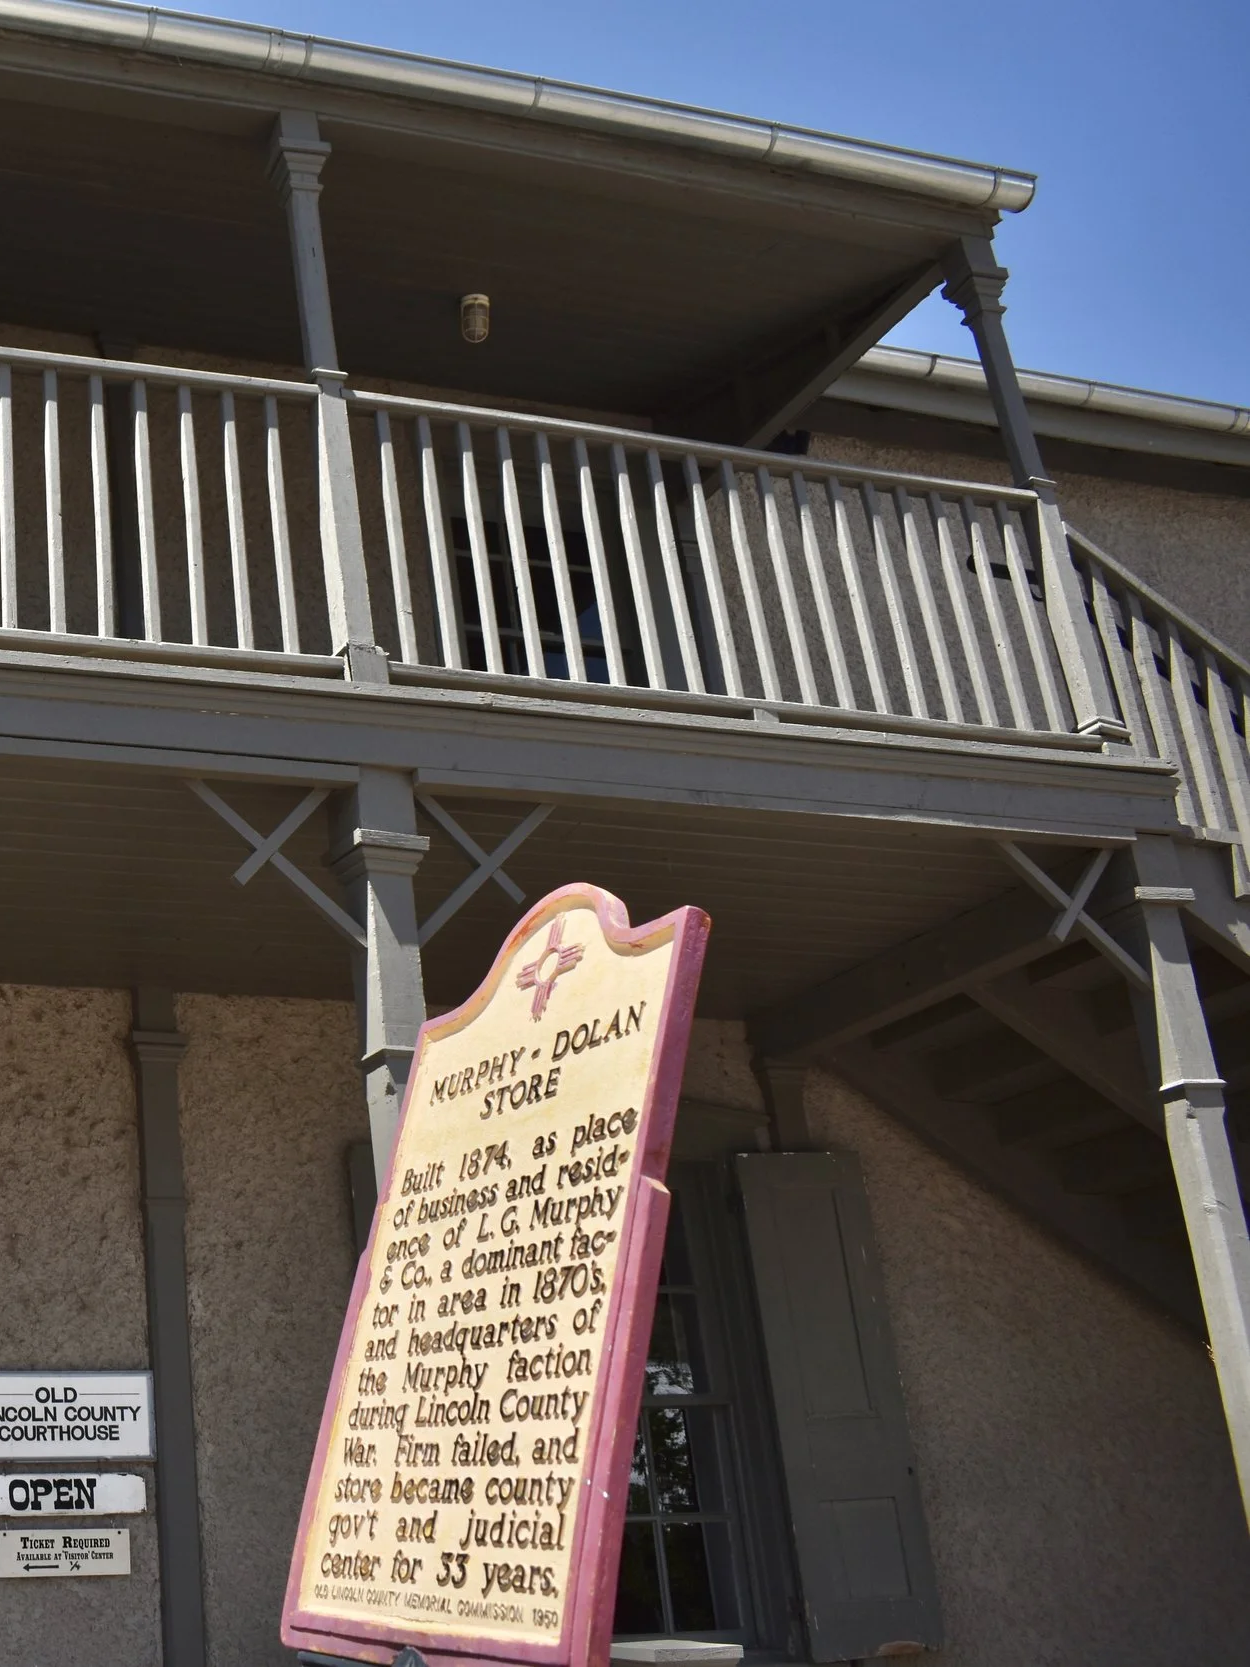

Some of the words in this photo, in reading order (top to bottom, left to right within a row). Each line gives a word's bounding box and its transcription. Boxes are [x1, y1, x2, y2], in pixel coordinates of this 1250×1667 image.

[429, 1046, 526, 1107] MURPHY
[551, 1000, 647, 1062] DOLAN
[480, 1066, 561, 1120] STORE
[401, 1160, 445, 1197] Built
[459, 1140, 512, 1181] 1874,
[532, 1130, 558, 1159] as
[570, 1107, 639, 1157] place
[393, 1197, 415, 1231] of
[417, 1181, 499, 1225] business
[505, 1164, 547, 1202] and
[557, 1144, 631, 1193] resid-
[387, 1232, 431, 1264] ence
[443, 1217, 467, 1250] of
[476, 1210, 495, 1243] L.
[529, 1184, 624, 1232] Murphy
[380, 1264, 393, 1295] &
[440, 1259, 453, 1283] a
[461, 1232, 565, 1278] dominant
[570, 1226, 617, 1261] fac-
[372, 1301, 399, 1329] tor
[408, 1293, 426, 1324] in
[437, 1286, 487, 1318] area
[500, 1275, 521, 1308] in
[364, 1329, 400, 1362] and
[407, 1313, 558, 1357] headquarters
[573, 1298, 604, 1335] of
[358, 1367, 388, 1396] the
[402, 1357, 489, 1396] Murphy
[506, 1343, 592, 1383] faction
[35, 1387, 78, 1403] OLD
[64, 1406, 141, 1422] COUNTY
[348, 1398, 410, 1433] during
[414, 1391, 491, 1427] Lincoln
[499, 1385, 590, 1428] County
[343, 1436, 378, 1467] War.
[394, 1431, 440, 1467] Firm
[450, 1430, 520, 1468] failed,
[532, 1427, 580, 1465] and
[8, 1478, 97, 1511] OPEN
[334, 1472, 382, 1503] store
[390, 1471, 476, 1505] became
[485, 1470, 576, 1511] county
[20, 1537, 55, 1549] TICKET
[62, 1536, 110, 1550] REQUIRED
[329, 1509, 379, 1547] gov't
[395, 1510, 438, 1544] and
[459, 1508, 566, 1550] judicial
[16, 1552, 51, 1561] AVAILABLE
[54, 1553, 62, 1561] AT
[91, 1551, 114, 1560] CENTER
[320, 1550, 381, 1581] center
[390, 1549, 423, 1584] for
[436, 1552, 470, 1589] 33
[314, 1584, 329, 1599] OLD
[331, 1584, 365, 1602] LINCOLN
[366, 1588, 402, 1606] COUNTY
[404, 1592, 452, 1614] MEMORIAL
[457, 1599, 524, 1623] COMMISSION
